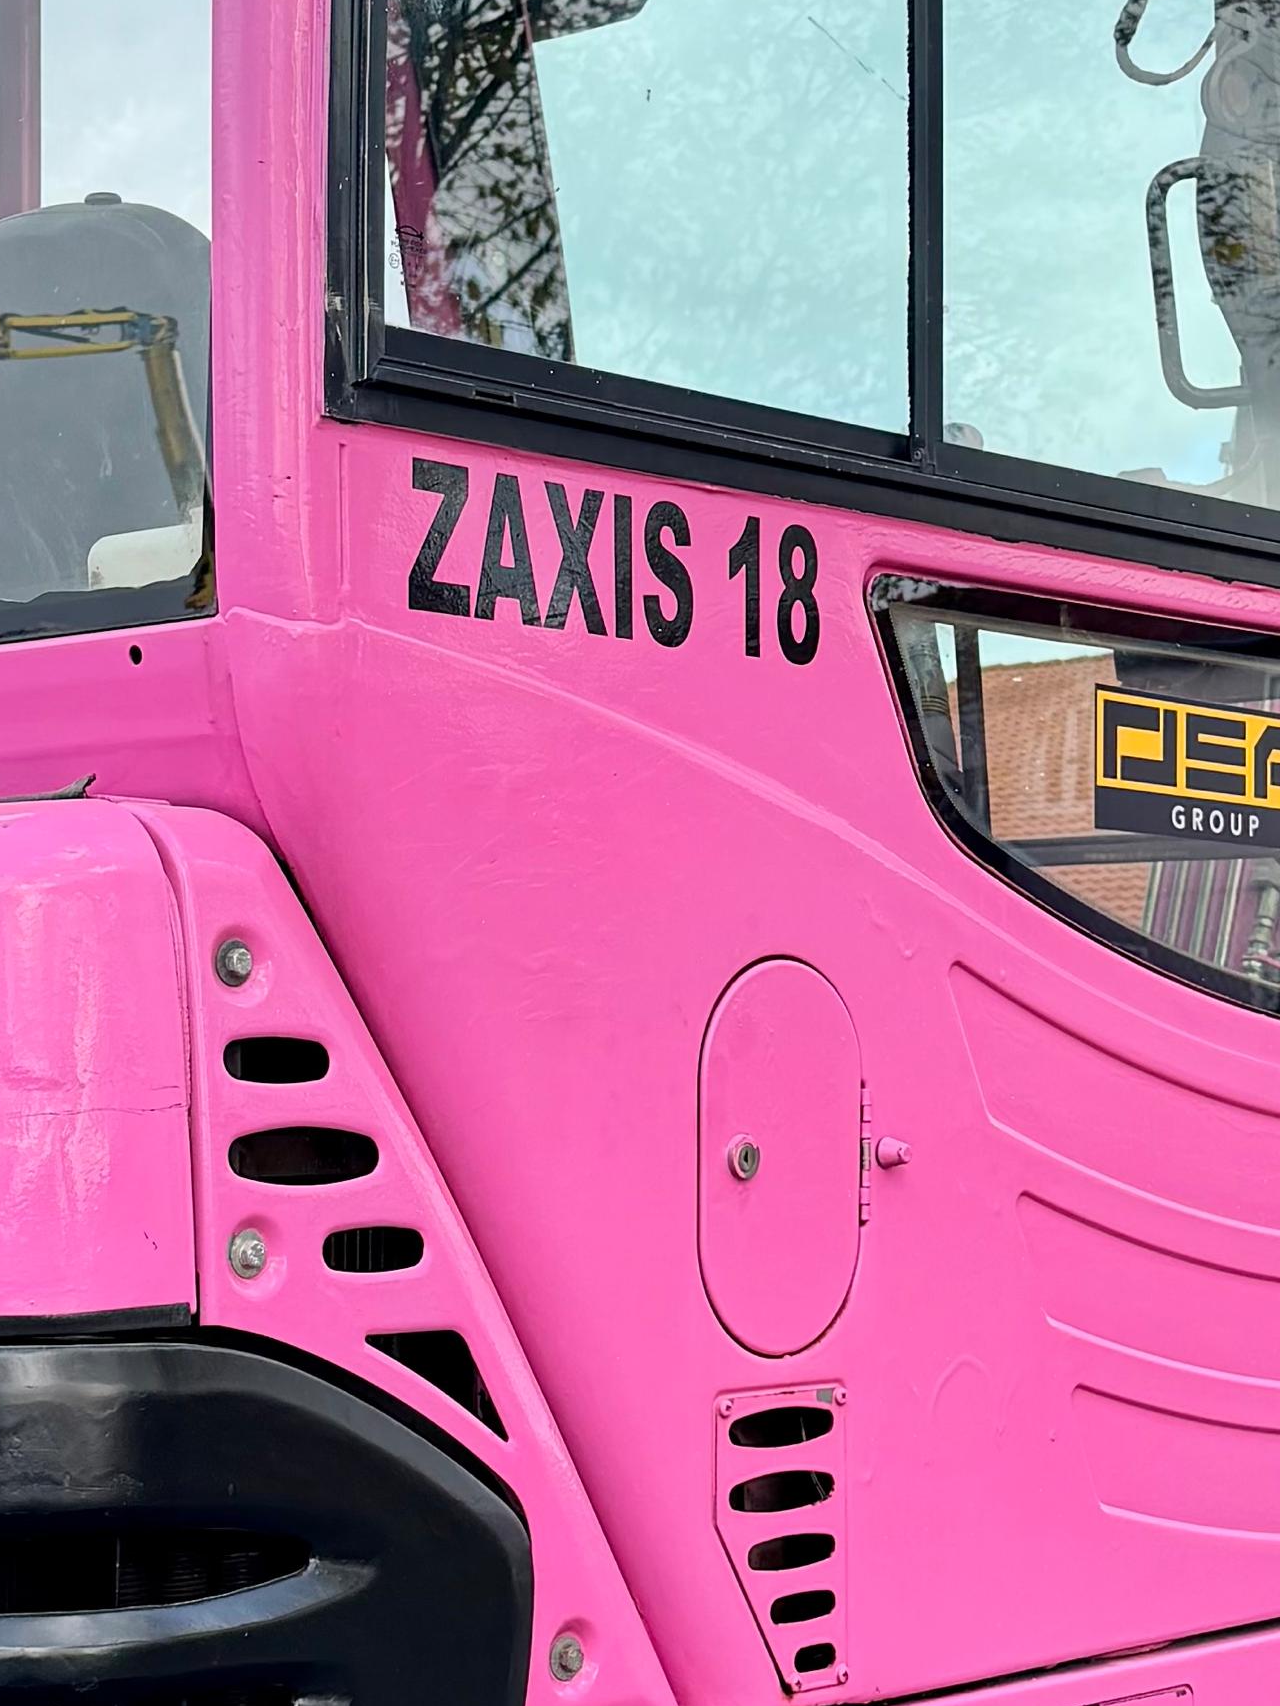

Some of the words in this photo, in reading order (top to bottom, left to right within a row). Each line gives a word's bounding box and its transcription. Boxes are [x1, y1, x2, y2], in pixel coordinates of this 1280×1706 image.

[408, 457, 694, 649] ZAXIS
[728, 515, 819, 666] 18
[1171, 805, 1261, 838] GROUP
